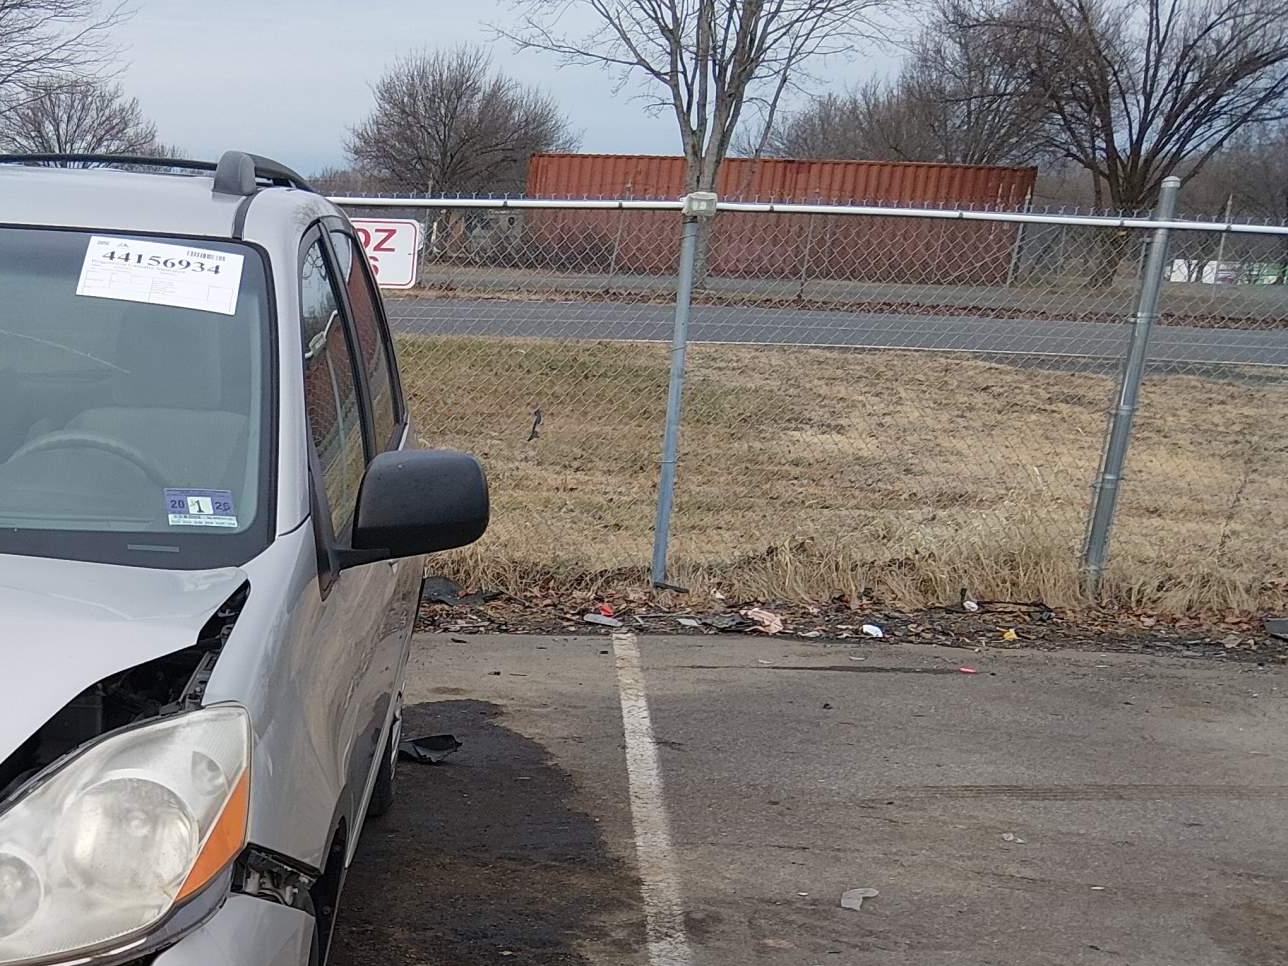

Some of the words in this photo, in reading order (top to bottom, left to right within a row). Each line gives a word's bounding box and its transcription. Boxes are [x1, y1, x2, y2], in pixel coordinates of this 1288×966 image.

[102, 250, 221, 275] 44156934
[170, 499, 185, 509] 20
[195, 499, 206, 513] 1
